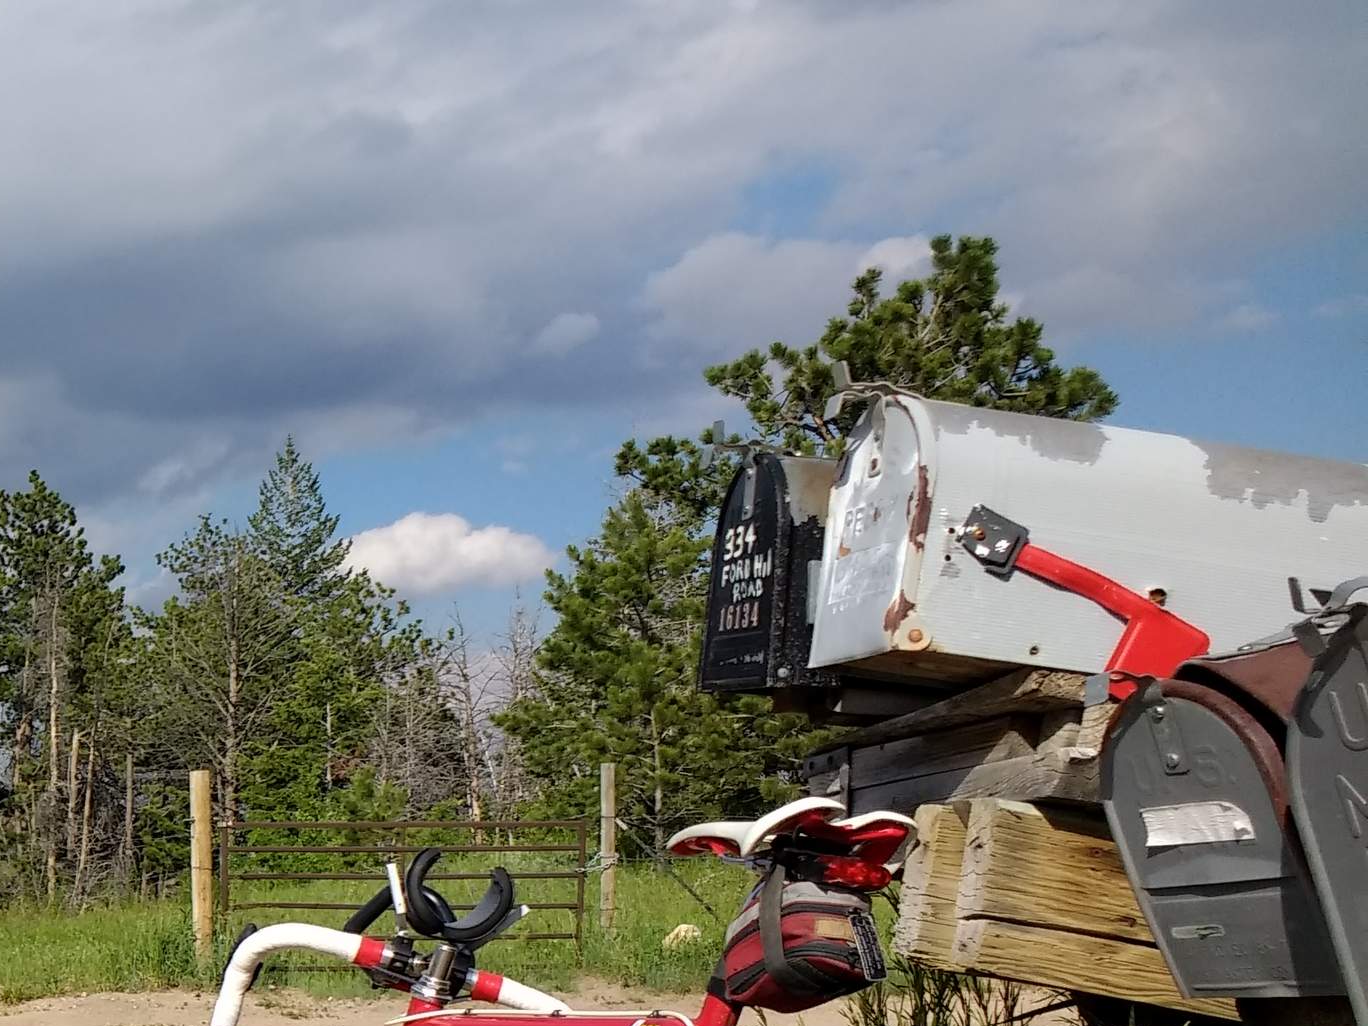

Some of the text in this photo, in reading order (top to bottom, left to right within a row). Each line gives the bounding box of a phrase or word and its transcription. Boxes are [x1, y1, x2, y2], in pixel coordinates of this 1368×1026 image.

[724, 522, 757, 561] 334
[721, 558, 751, 588] FORD
[733, 578, 763, 602] ROAD
[718, 602, 759, 632] 16134
